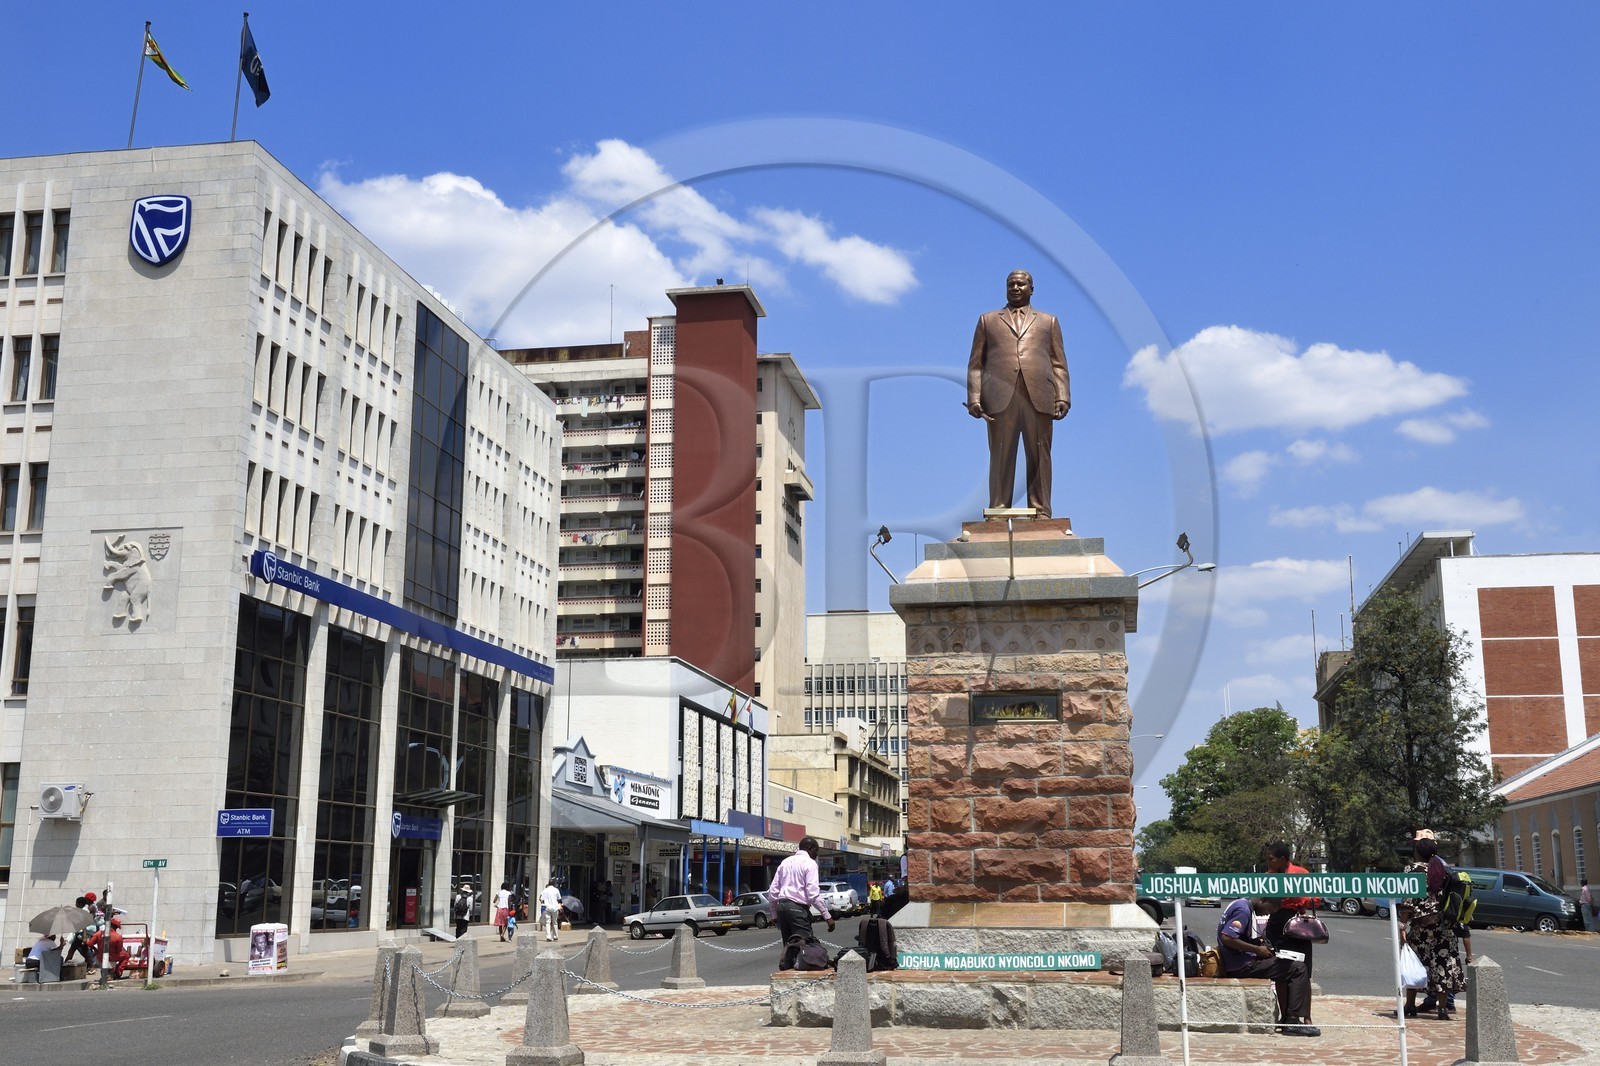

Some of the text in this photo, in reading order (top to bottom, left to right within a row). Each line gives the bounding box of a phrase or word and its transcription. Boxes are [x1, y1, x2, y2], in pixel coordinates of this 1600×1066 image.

[277, 566, 320, 592] Stanbic Bank
[575, 764, 586, 774] BED
[631, 796, 659, 807] General
[143, 860, 154, 868] 8TH
[1145, 876, 1420, 896] JOSHUA MQABUKO NYONGOLO NKOMO
[899, 954, 1096, 970] JOSHUA MQABUKO NYONGOLO NKOMO
